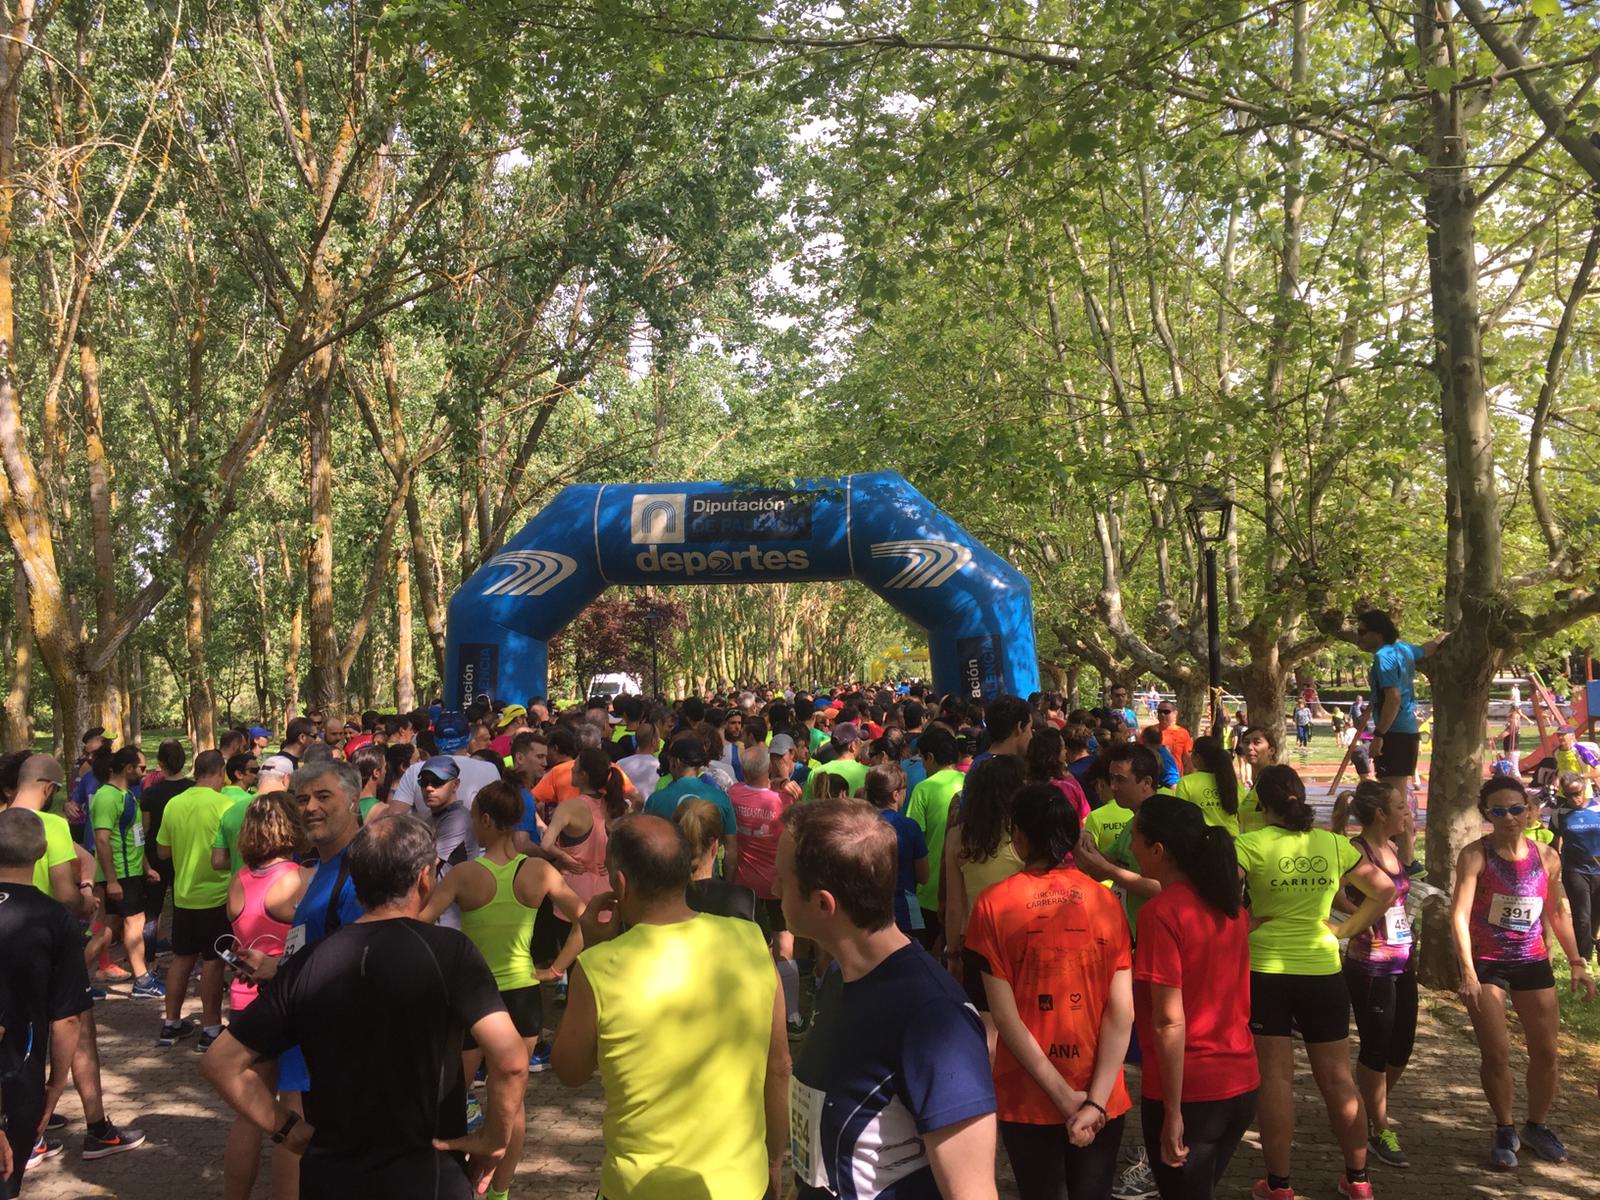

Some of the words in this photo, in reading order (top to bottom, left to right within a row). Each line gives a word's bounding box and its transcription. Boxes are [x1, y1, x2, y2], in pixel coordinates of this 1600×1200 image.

[693, 498, 785, 515] Diputación
[636, 544, 810, 576] deportes
[1103, 822, 1127, 832] PUEN
[1270, 876, 1335, 887] CARRIÓN
[1026, 896, 1068, 910] CARRERAS
[1502, 906, 1531, 920] 391
[1048, 1043, 1080, 1059] ANA
